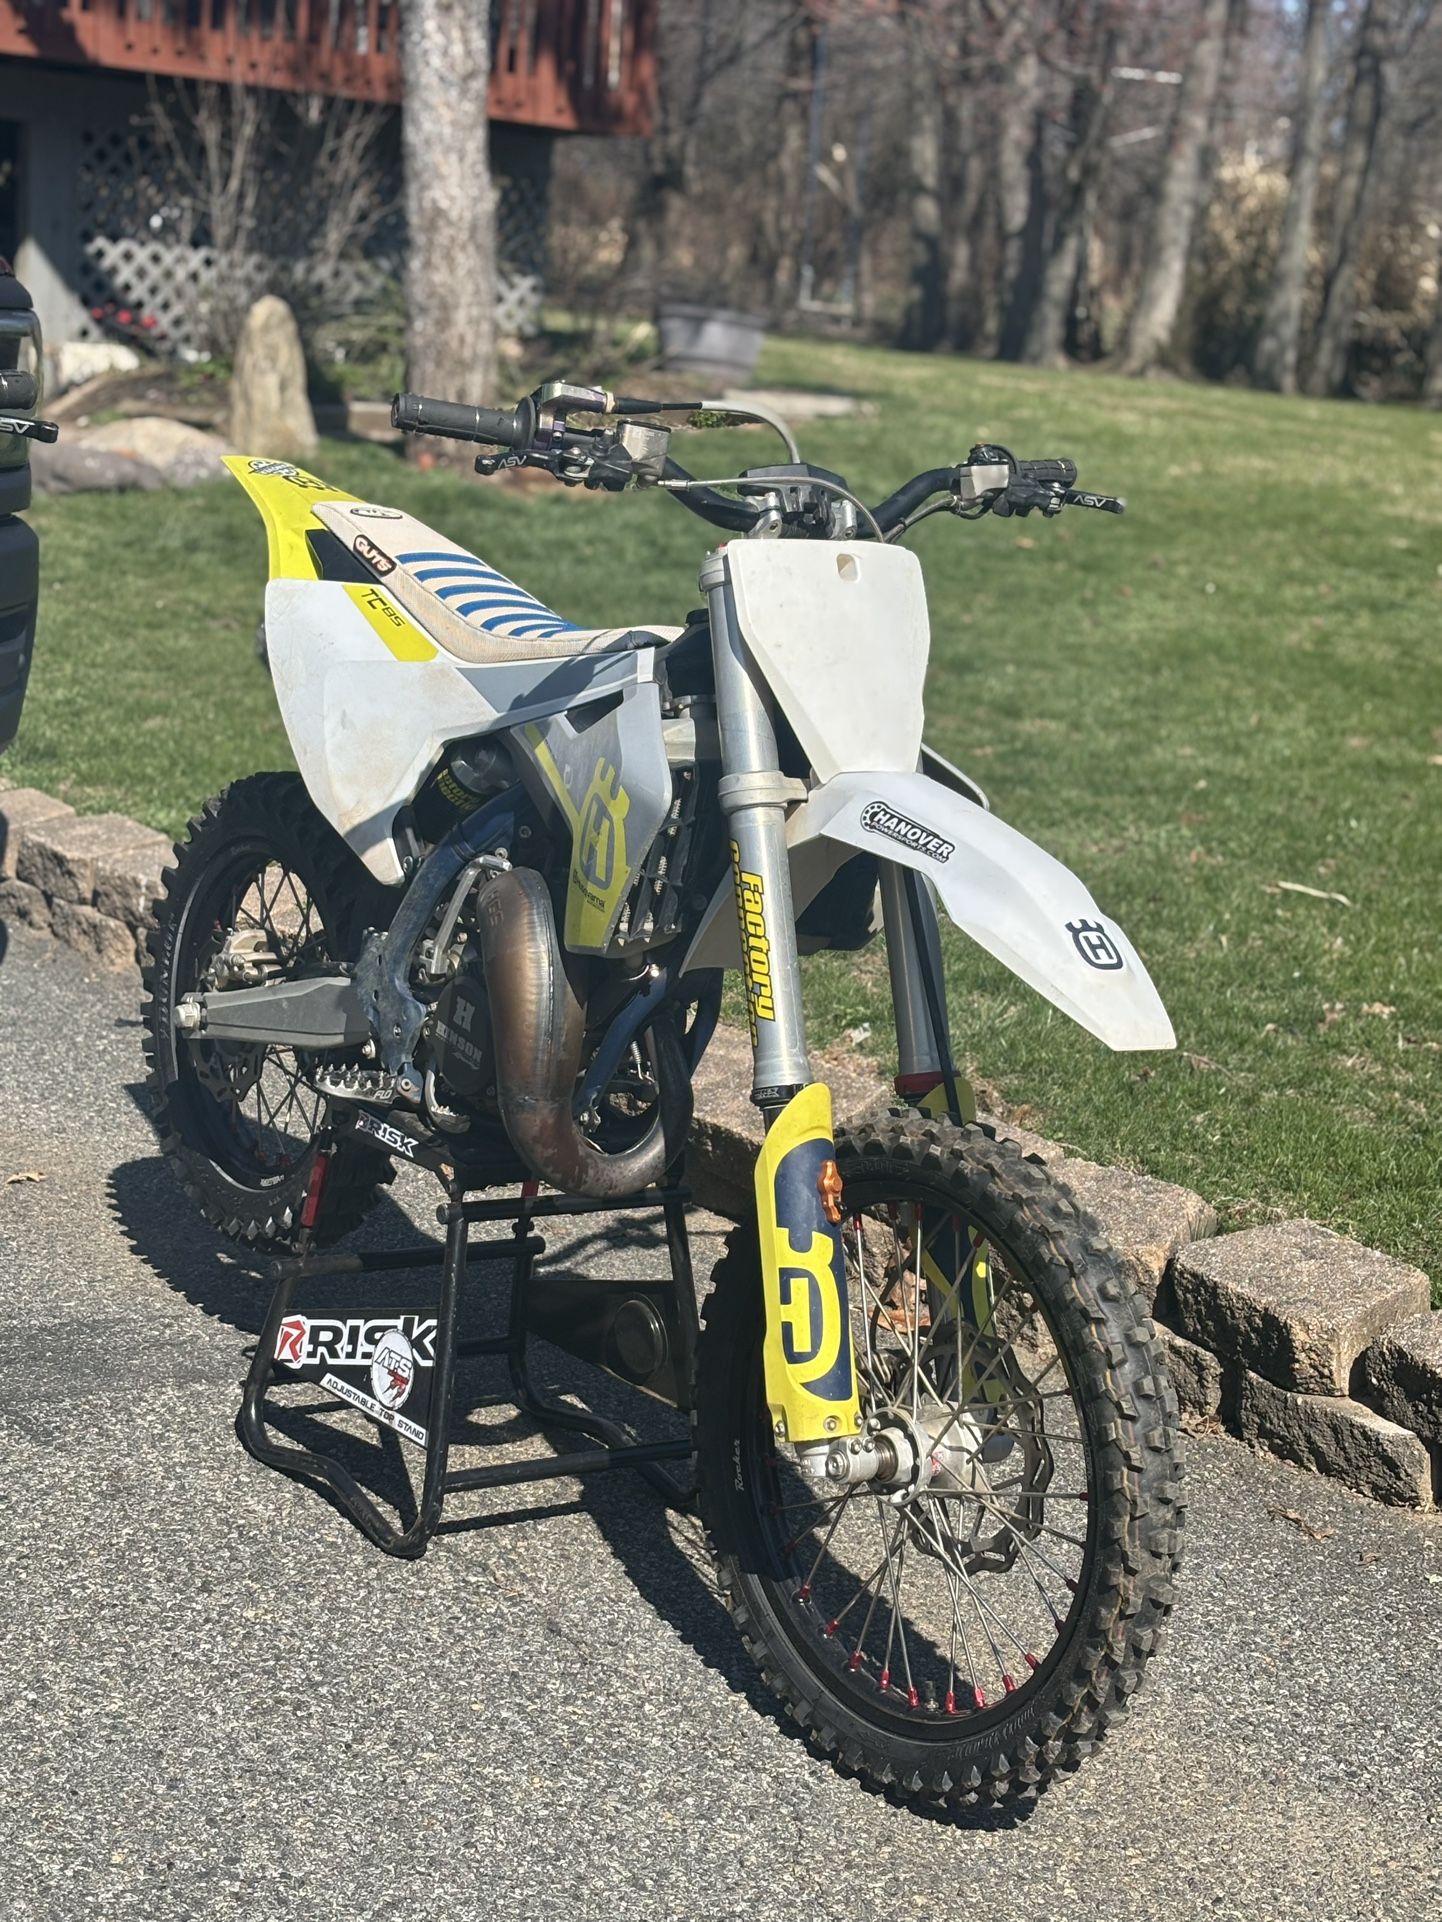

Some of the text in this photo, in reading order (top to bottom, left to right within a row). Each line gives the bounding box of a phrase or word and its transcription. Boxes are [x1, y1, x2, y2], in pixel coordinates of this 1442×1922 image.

[0, 420, 30, 434] SV
[498, 455, 527, 469] ASV
[1073, 494, 1106, 507] ASV
[355, 537, 392, 572] GUTS
[873, 811, 953, 857] HANOVER
[366, 1117, 419, 1158] RISK
[326, 1378, 425, 1441] ADJUSTABLE TOP STAND
